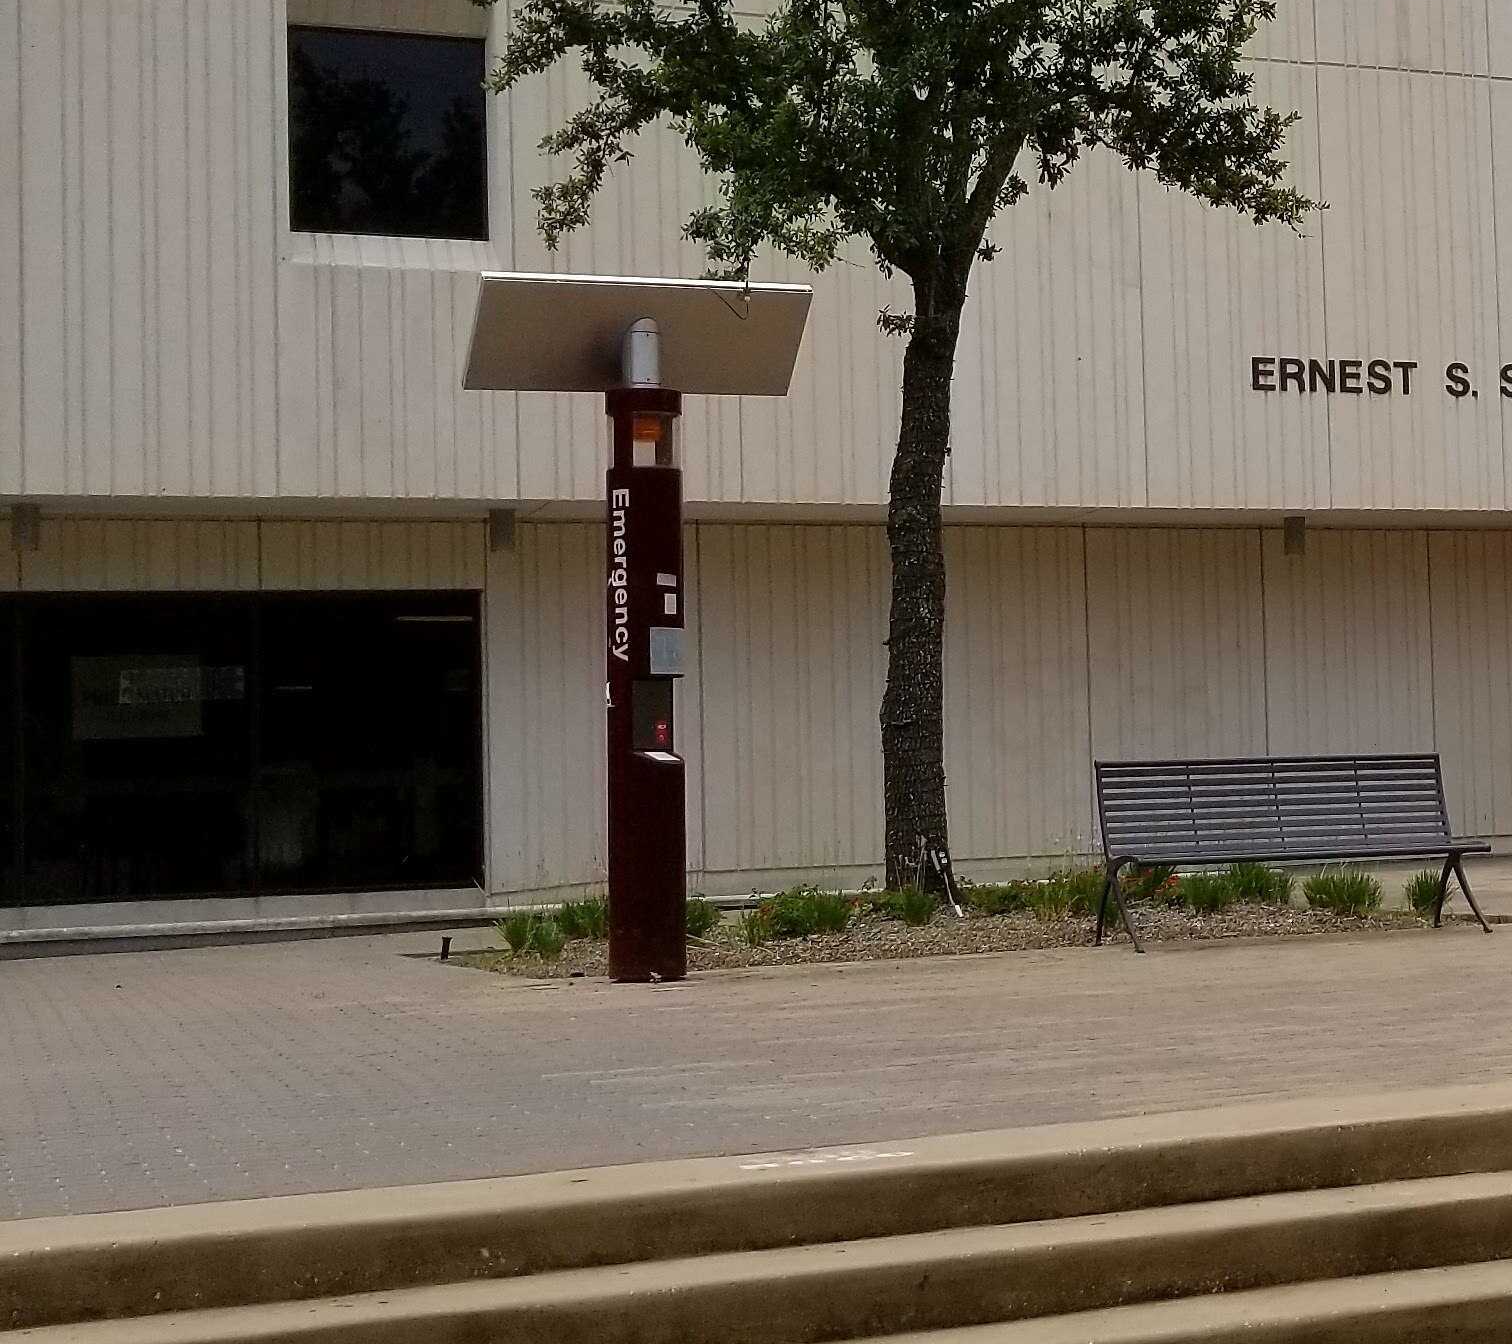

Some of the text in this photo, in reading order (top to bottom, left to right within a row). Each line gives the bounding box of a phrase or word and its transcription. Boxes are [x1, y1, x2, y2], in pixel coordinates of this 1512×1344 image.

[1251, 356, 1418, 399] ERNEST
[1445, 362, 1479, 401] S.
[611, 488, 630, 662] Emergency
